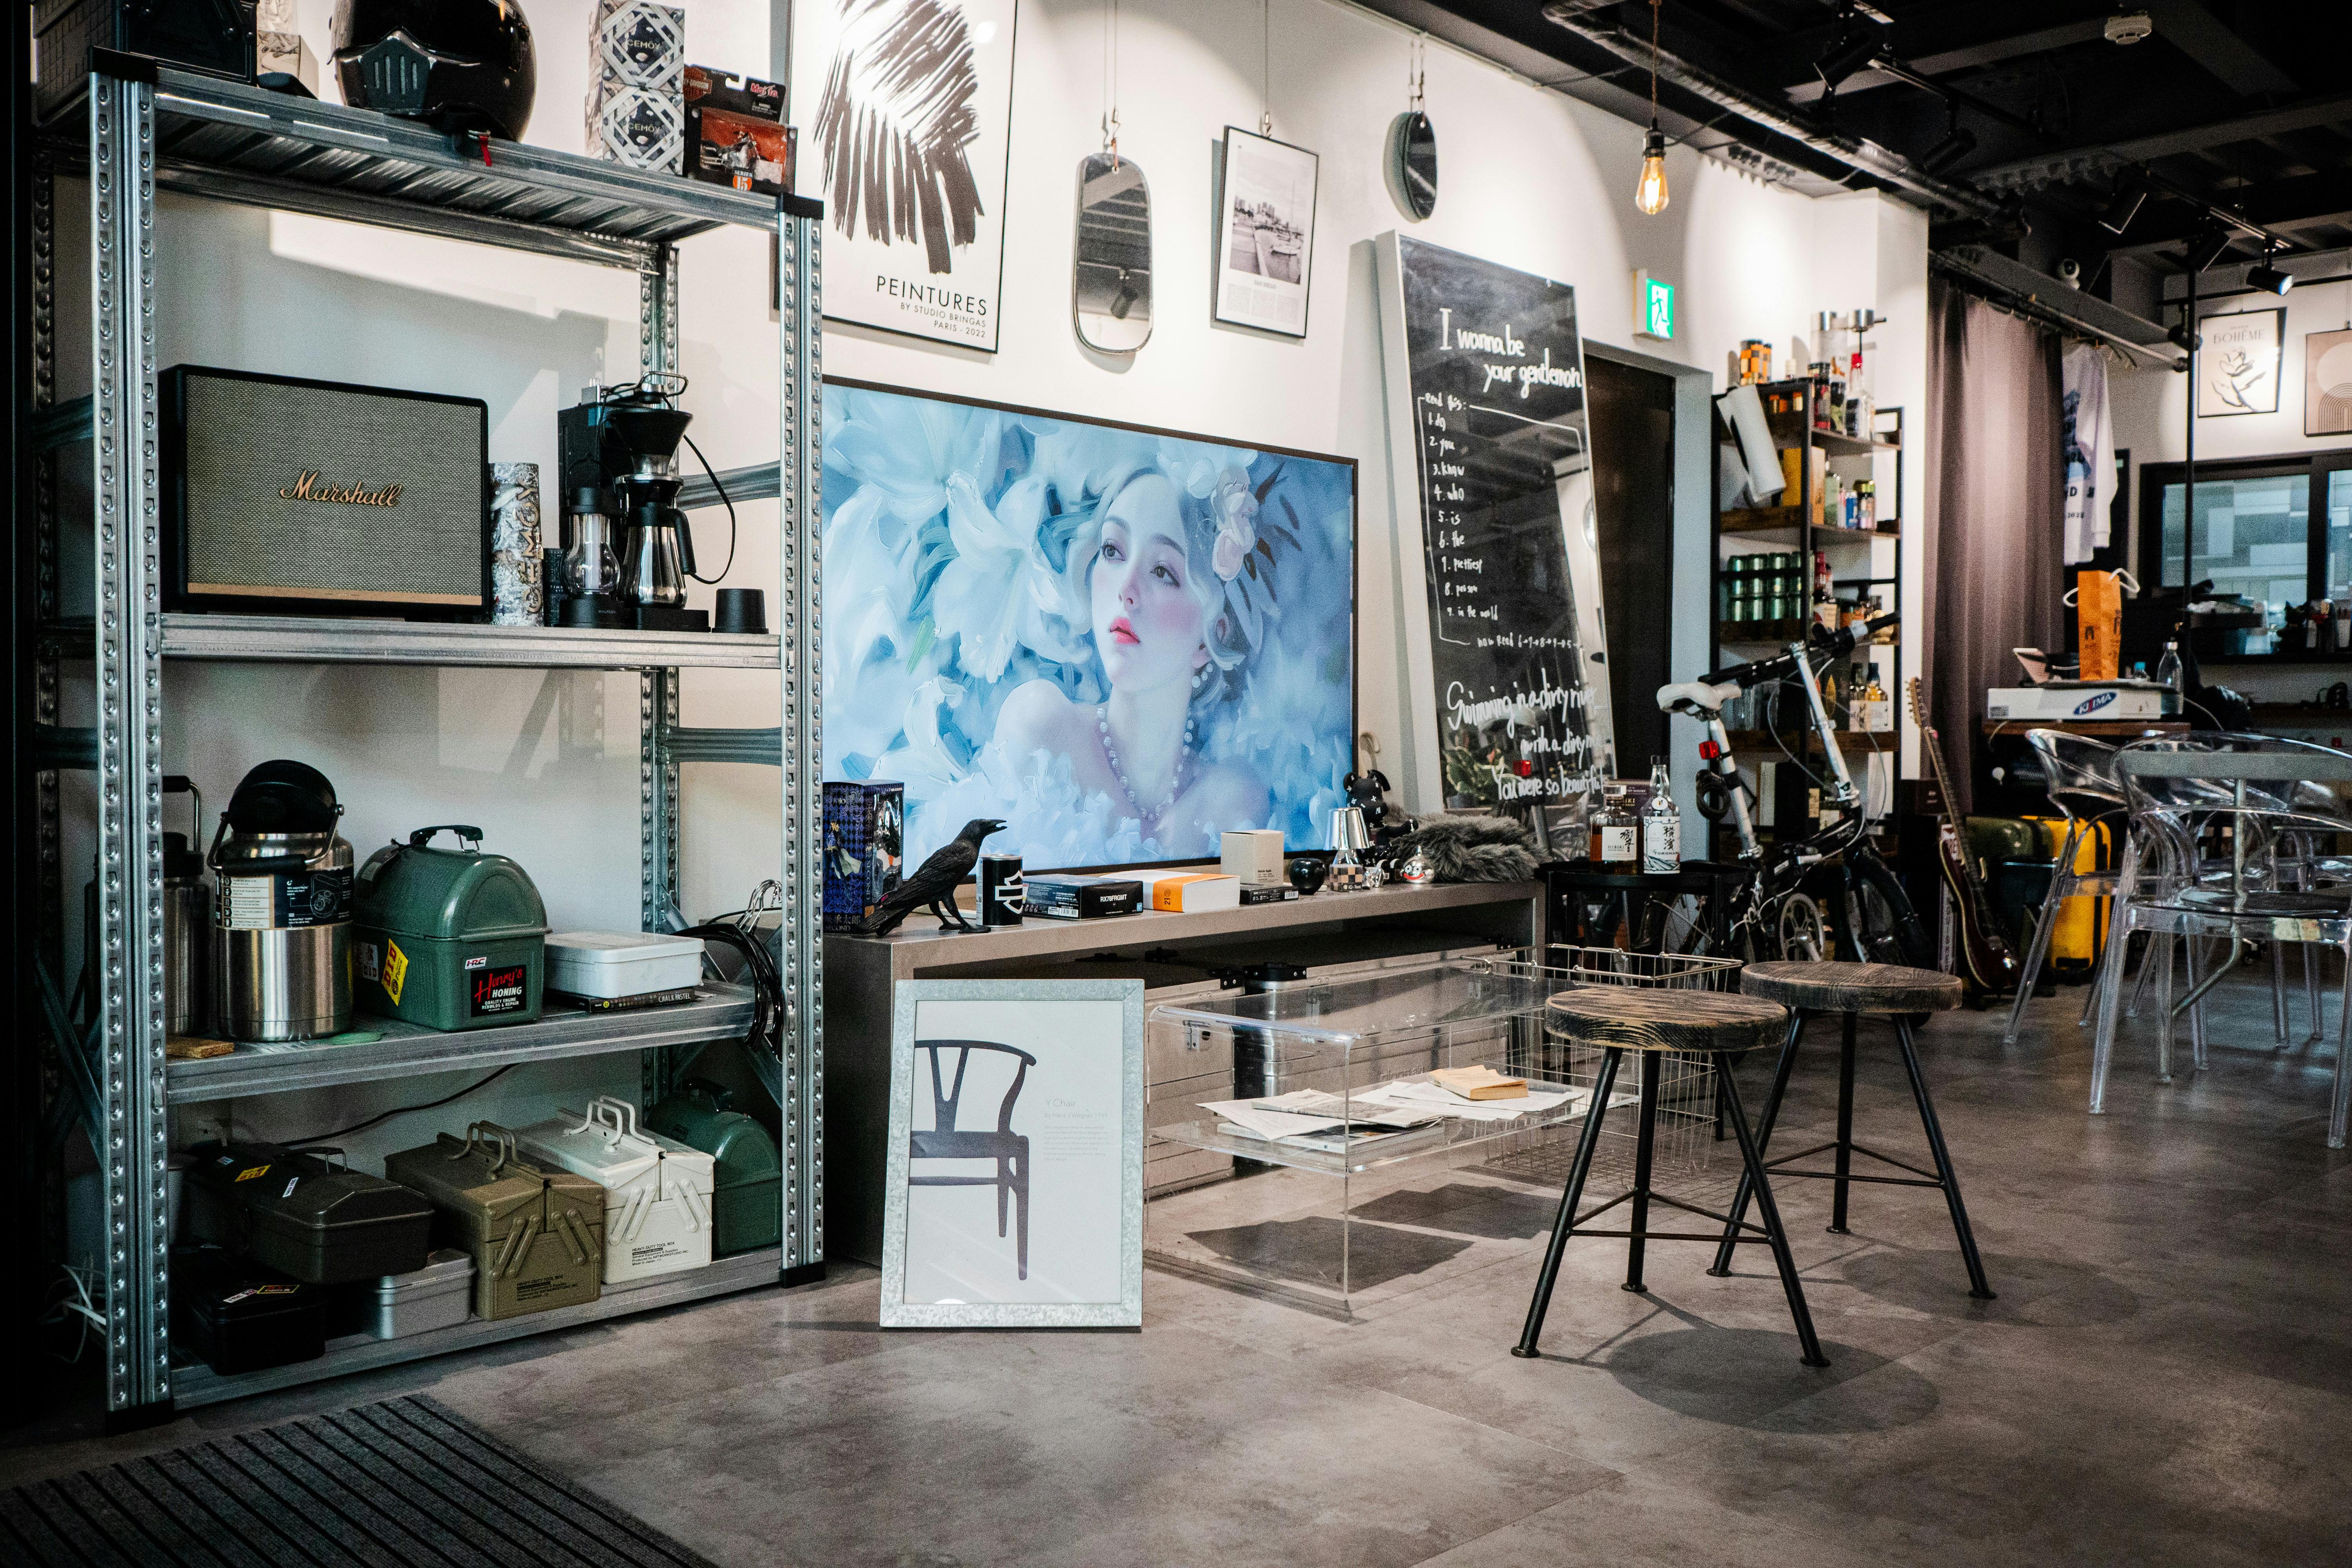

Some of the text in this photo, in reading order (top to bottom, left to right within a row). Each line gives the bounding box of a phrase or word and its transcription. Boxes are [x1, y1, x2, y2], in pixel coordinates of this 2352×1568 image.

[877, 275, 987, 316] PEINTURES
[901, 302, 986, 327] BY STUDIO BRINGAS
[934, 320, 957, 332] PARIS
[966, 327, 986, 338] 2022
[1439, 307, 1452, 350] I
[1506, 324, 1526, 357] be
[1483, 363, 1517, 393] your
[1440, 438, 1455, 456] you
[280, 470, 402, 507] Marshall
[1447, 483, 1465, 501] who
[1451, 511, 1461, 525] is
[1451, 531, 1465, 548] the
[1546, 778, 1560, 796] so
[1100, 894, 1127, 902] RX78FRGMT
[467, 958, 485, 967] HRC
[492, 986, 522, 998] HONING
[658, 994, 674, 1003] CHALK
[1053, 1098, 1076, 1107] Chair
